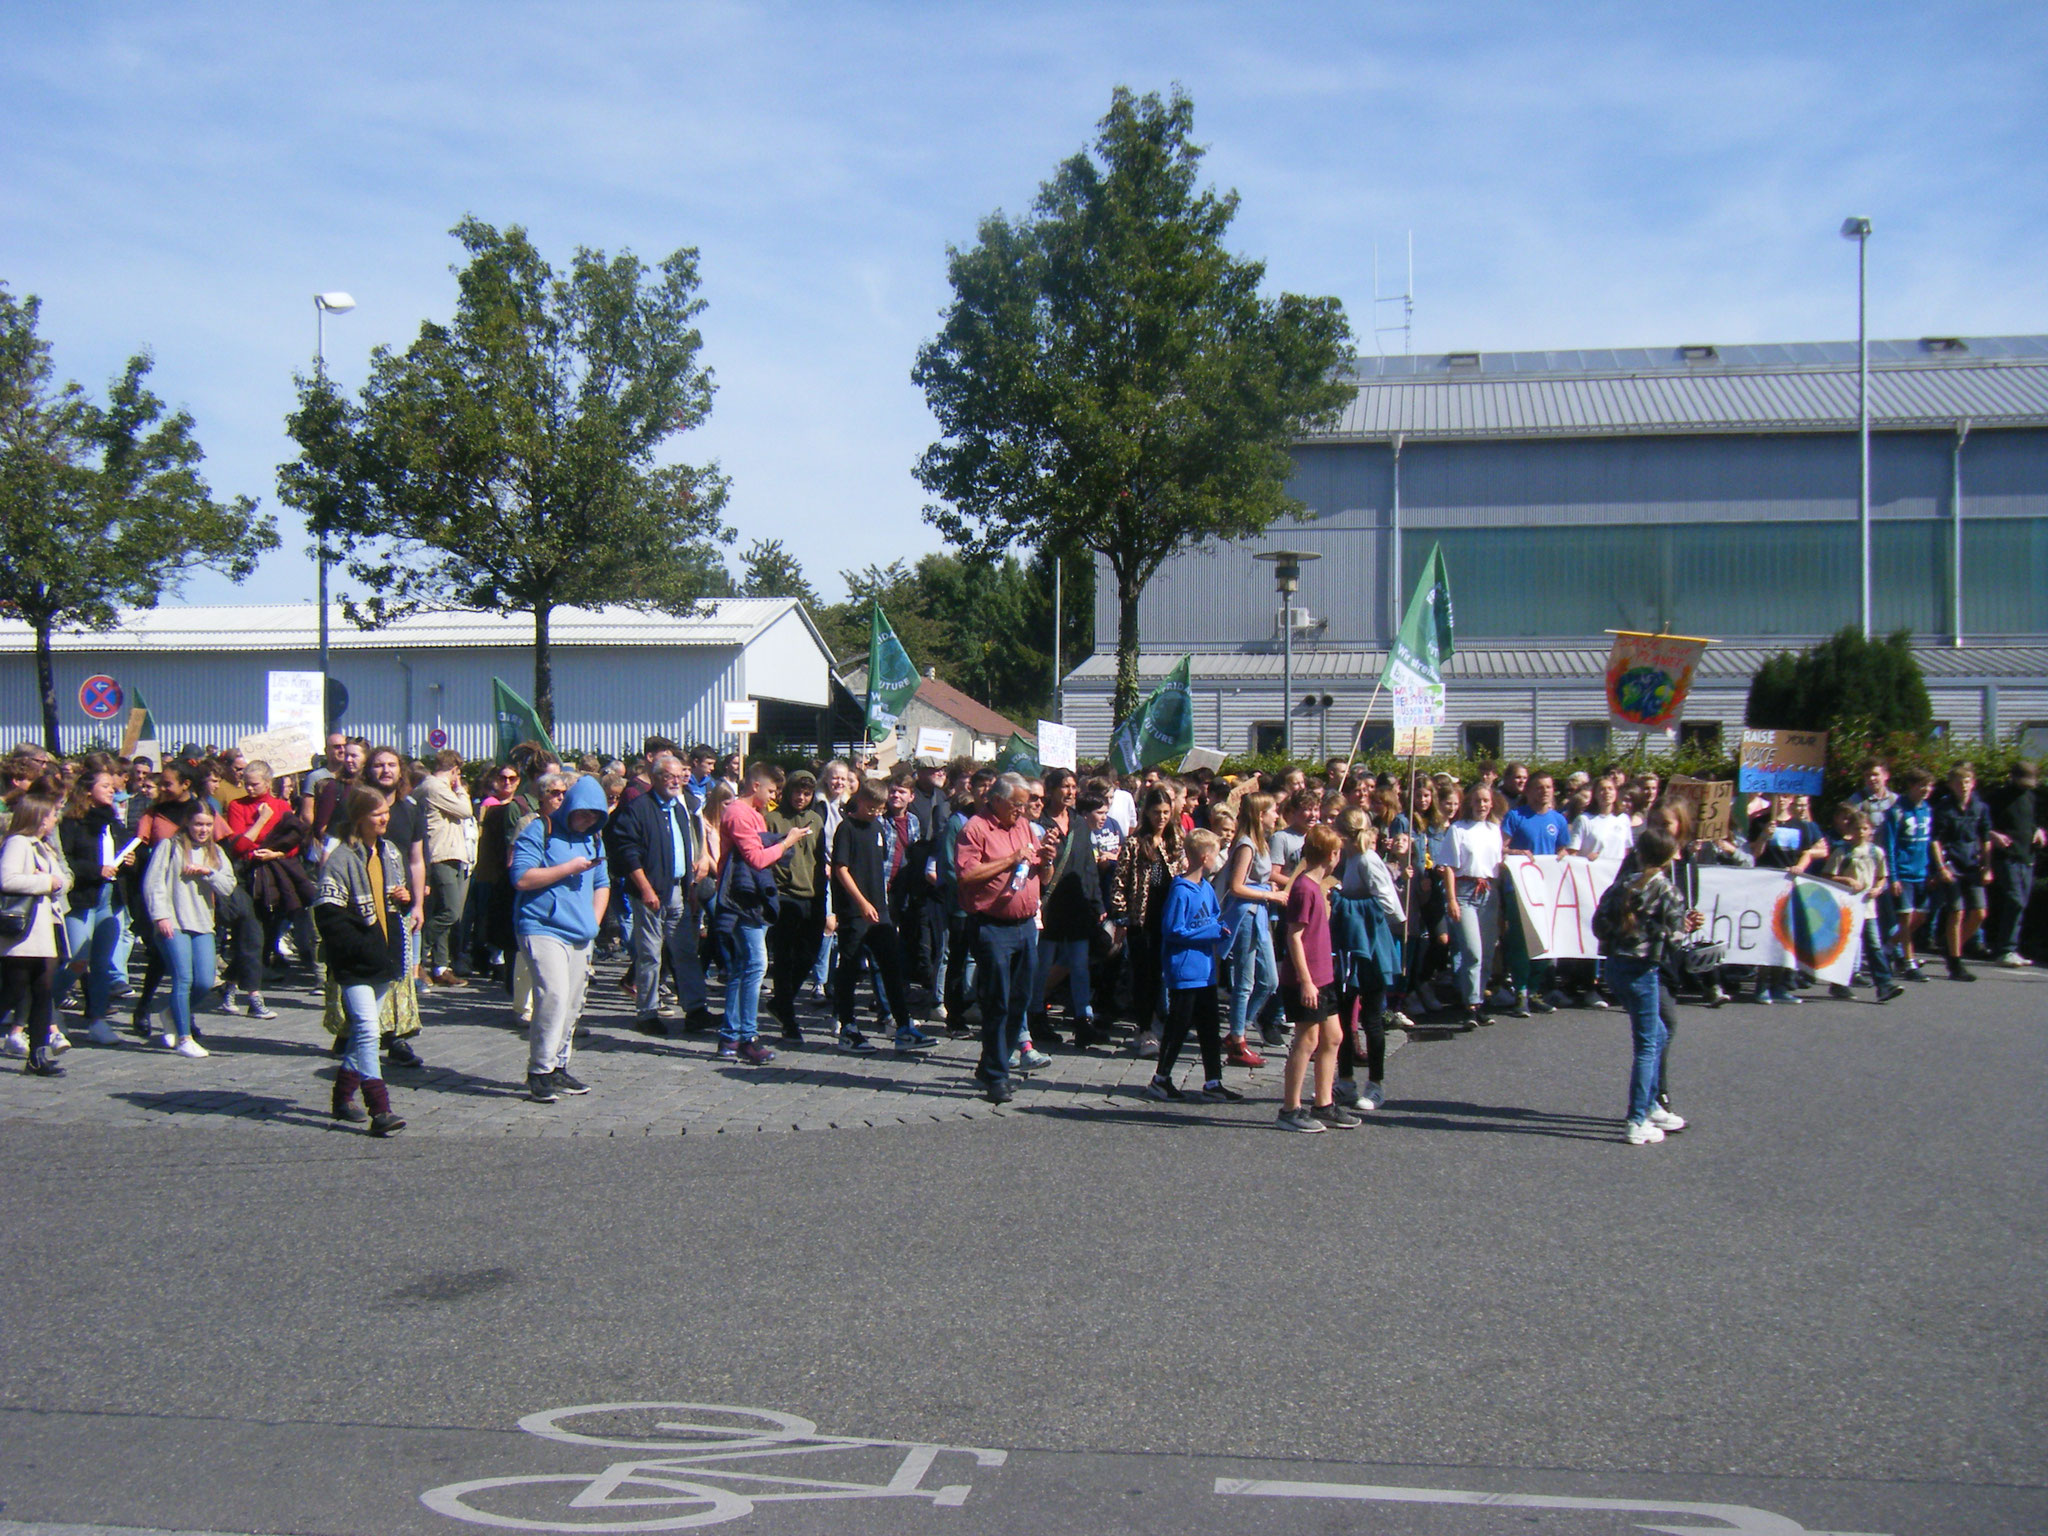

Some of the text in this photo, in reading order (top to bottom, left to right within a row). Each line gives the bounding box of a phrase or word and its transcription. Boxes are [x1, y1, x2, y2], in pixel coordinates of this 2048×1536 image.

[1619, 636, 1662, 650] SAVE
[1636, 650, 1685, 668] PLANET
[879, 678, 911, 692] UTURE
[1743, 730, 1777, 745] RAISE
[1742, 745, 1779, 764] VOICE
[1713, 782, 1733, 799] IST
[1744, 772, 1768, 791] Sea
[1696, 801, 1720, 822] ES
[1519, 861, 1599, 955] SA
[1711, 893, 1763, 951] he
